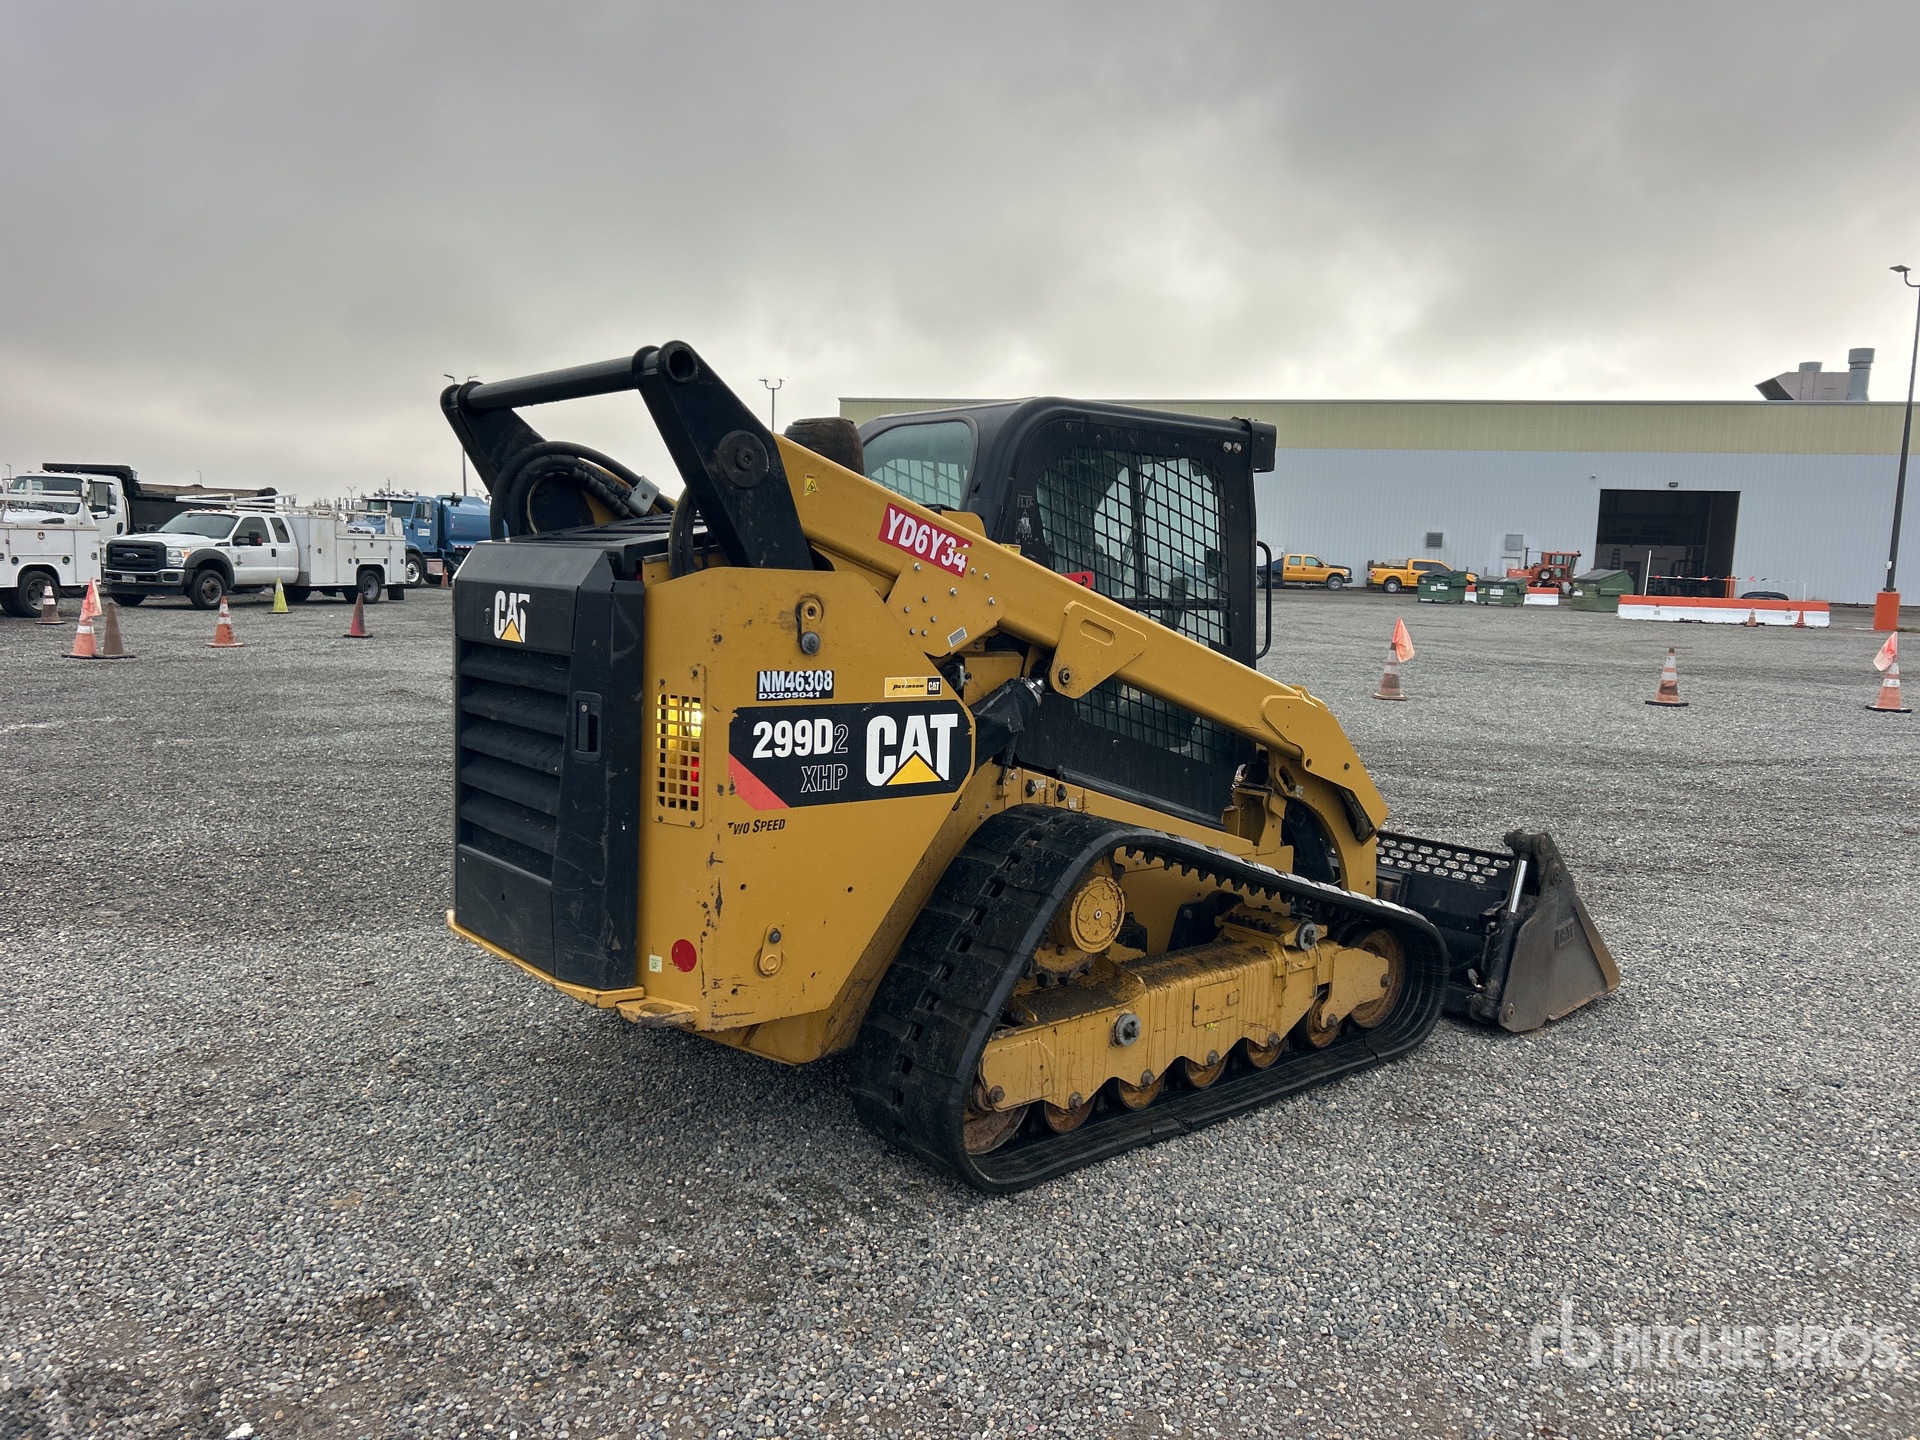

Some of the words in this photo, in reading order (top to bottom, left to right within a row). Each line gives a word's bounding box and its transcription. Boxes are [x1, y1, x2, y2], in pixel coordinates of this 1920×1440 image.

[887, 507, 970, 573] YD6Y34
[494, 590, 530, 643] CAT
[758, 691, 820, 700] DX205041
[759, 670, 833, 692] NM46308
[928, 681, 941, 691] CAT
[865, 713, 959, 787] CAT
[800, 764, 848, 793] XHP
